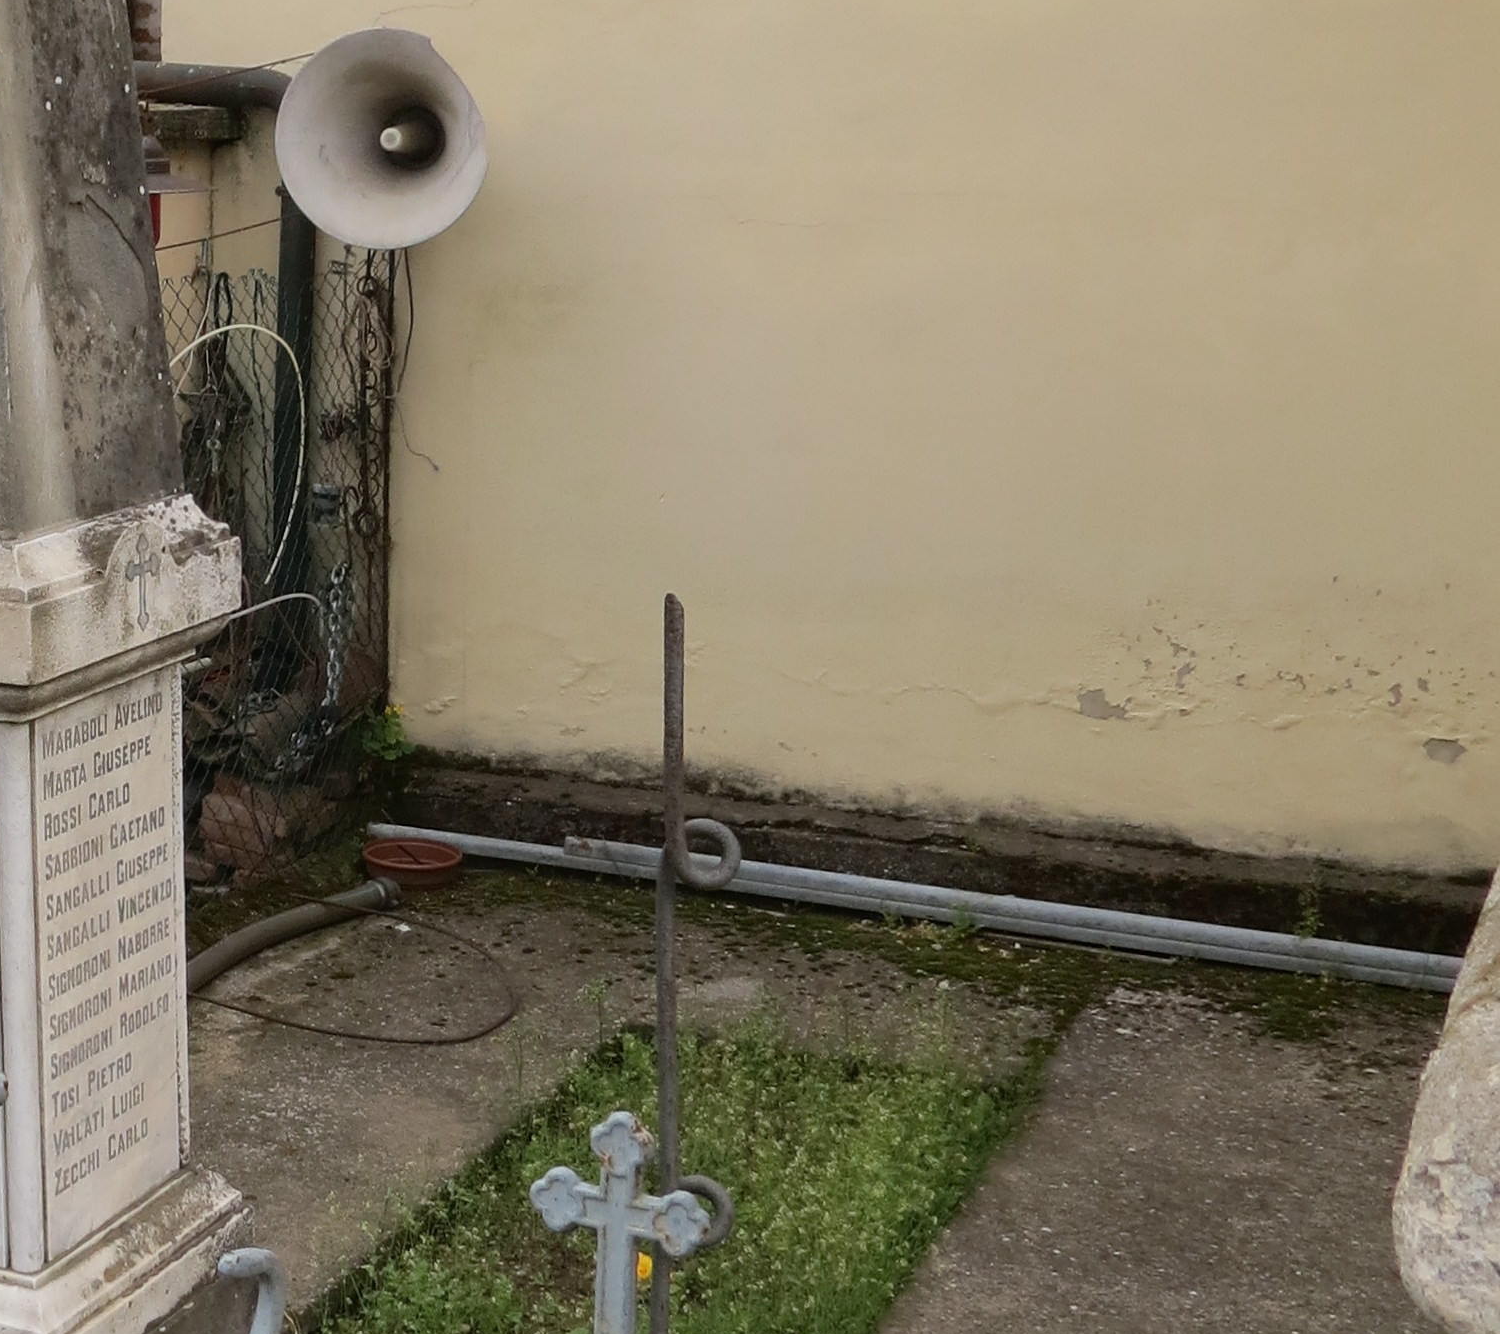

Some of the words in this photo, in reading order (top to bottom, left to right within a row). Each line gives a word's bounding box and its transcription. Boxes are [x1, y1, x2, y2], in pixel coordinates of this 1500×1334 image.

[42, 713, 108, 760] MARABOLI
[114, 691, 163, 731] AVELINO
[43, 763, 88, 801] MARTA
[93, 735, 152, 779] GIUSEPPE
[44, 804, 82, 842] ROSSI
[88, 782, 130, 821] CARLO
[109, 806, 166, 850] GAETANO
[46, 870, 110, 922] SANGALLI
[116, 842, 169, 886] GIUSEPPE
[47, 909, 110, 962] SANGALLI
[117, 878, 172, 924] VINCENZO
[48, 948, 111, 1001] SIGNORONI
[117, 917, 170, 963] NABORRE
[49, 987, 112, 1041] SIGNORONI
[119, 953, 172, 1001] MARIANO
[50, 1026, 113, 1081] SIGNORONI
[120, 992, 169, 1039] RODOLFO
[51, 1084, 80, 1118] TOSI
[87, 1051, 133, 1097] PIETRO
[111, 1081, 145, 1120] LUIGI
[54, 1148, 100, 1197] ZECCHI
[107, 1117, 149, 1161] CARLO
